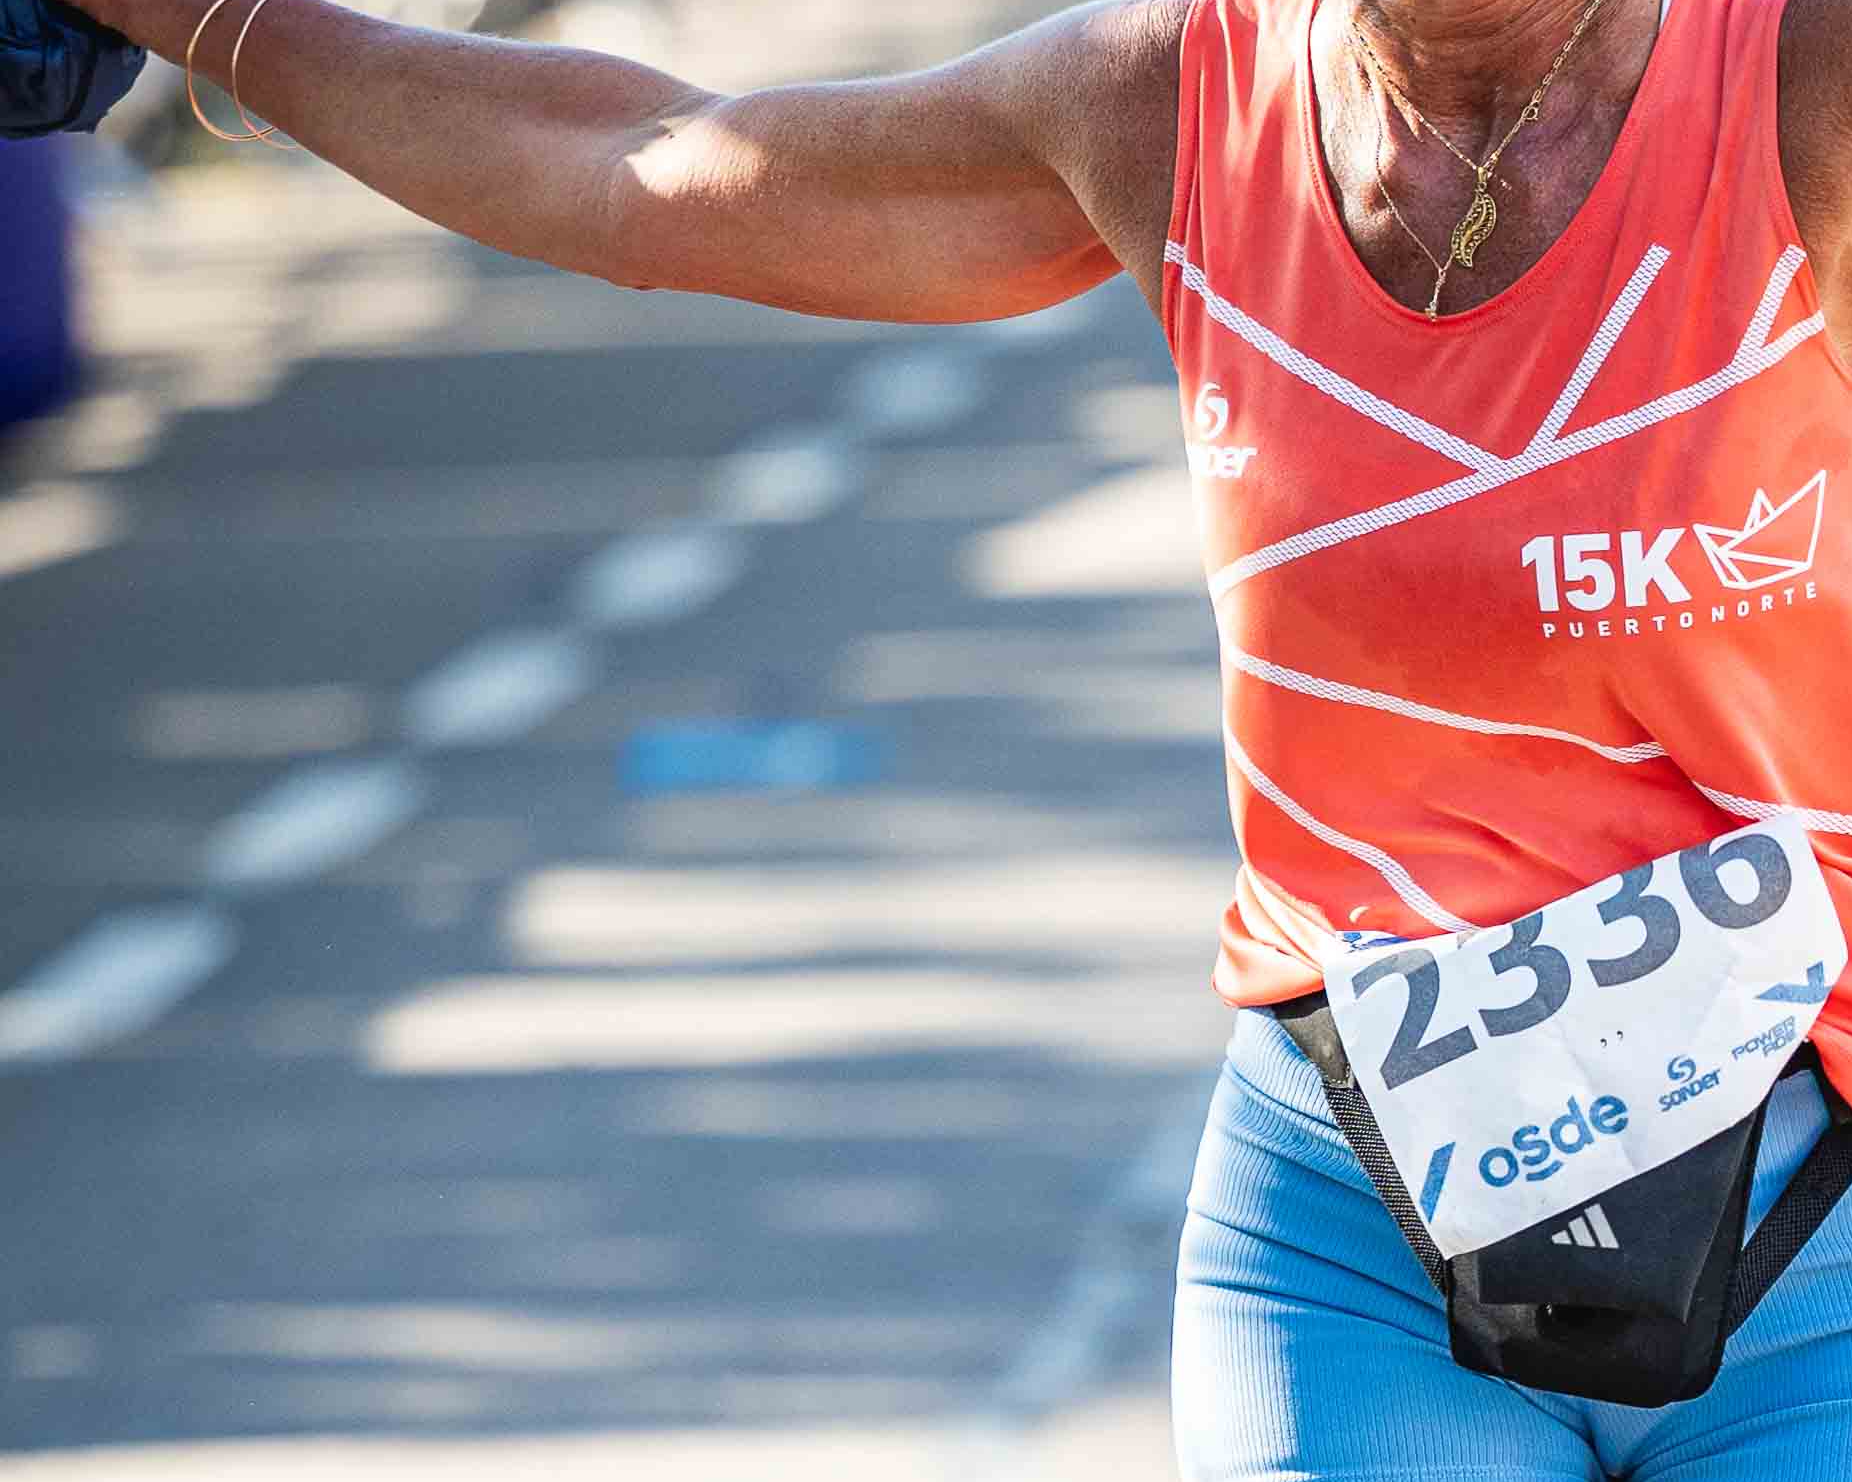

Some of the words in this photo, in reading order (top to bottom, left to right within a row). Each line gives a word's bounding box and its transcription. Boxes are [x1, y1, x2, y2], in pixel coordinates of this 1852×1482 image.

[1520, 527, 1692, 613] 15K
[1542, 611, 1694, 639] PUERTO
[1711, 581, 1817, 624] NORTE
[1351, 832, 1792, 1091] 2336
[1731, 1015, 1796, 1060] POWER
[1478, 1094, 1630, 1188] osde
